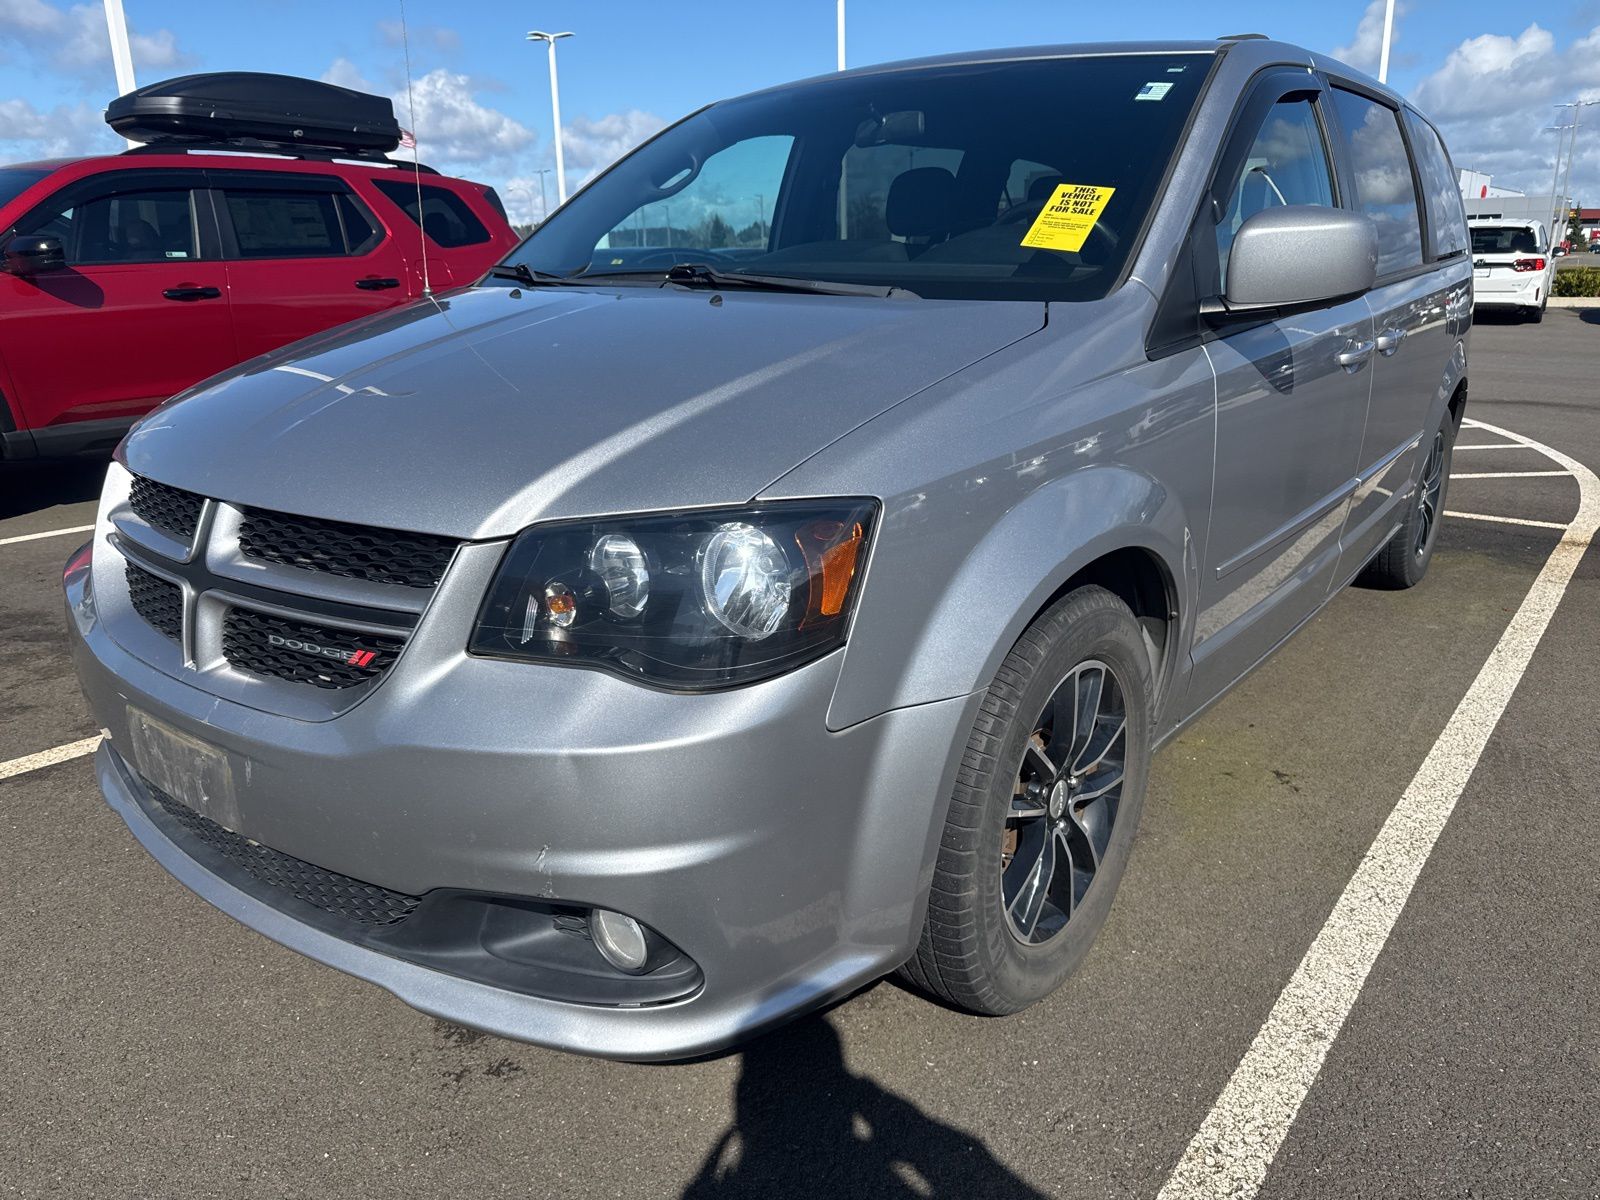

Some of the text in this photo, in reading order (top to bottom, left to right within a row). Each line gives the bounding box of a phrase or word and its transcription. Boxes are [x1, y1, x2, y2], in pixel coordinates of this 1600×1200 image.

[1061, 192, 1102, 201] VEHICLE
[1049, 205, 1096, 216] FOR SALE
[269, 635, 356, 661] DODGE
